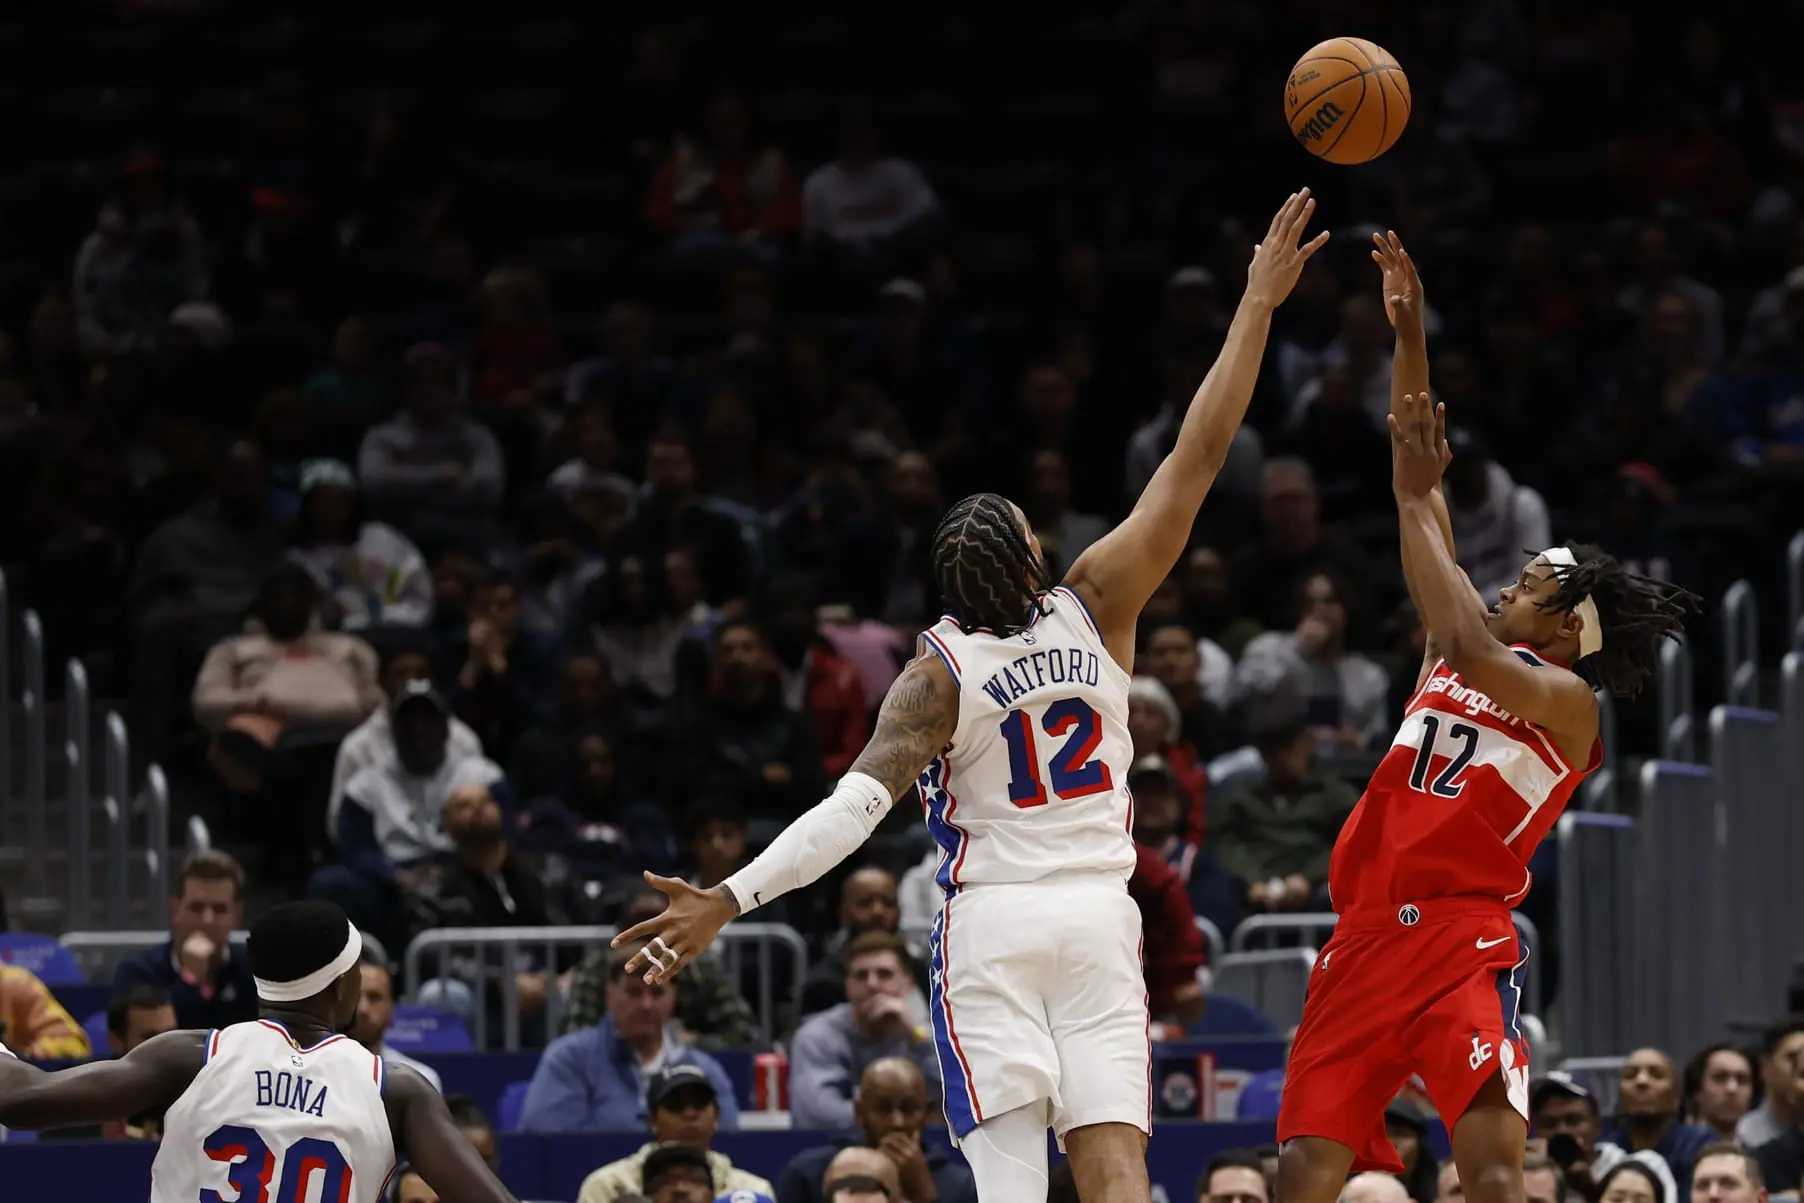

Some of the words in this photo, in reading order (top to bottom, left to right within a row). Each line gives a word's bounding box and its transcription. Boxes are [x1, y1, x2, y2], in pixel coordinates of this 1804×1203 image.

[982, 649, 1100, 709] WATFORD
[1000, 696, 1114, 809] 12
[1408, 714, 1480, 799] 12
[255, 1070, 328, 1117] BONA
[199, 1124, 353, 1203] 30
